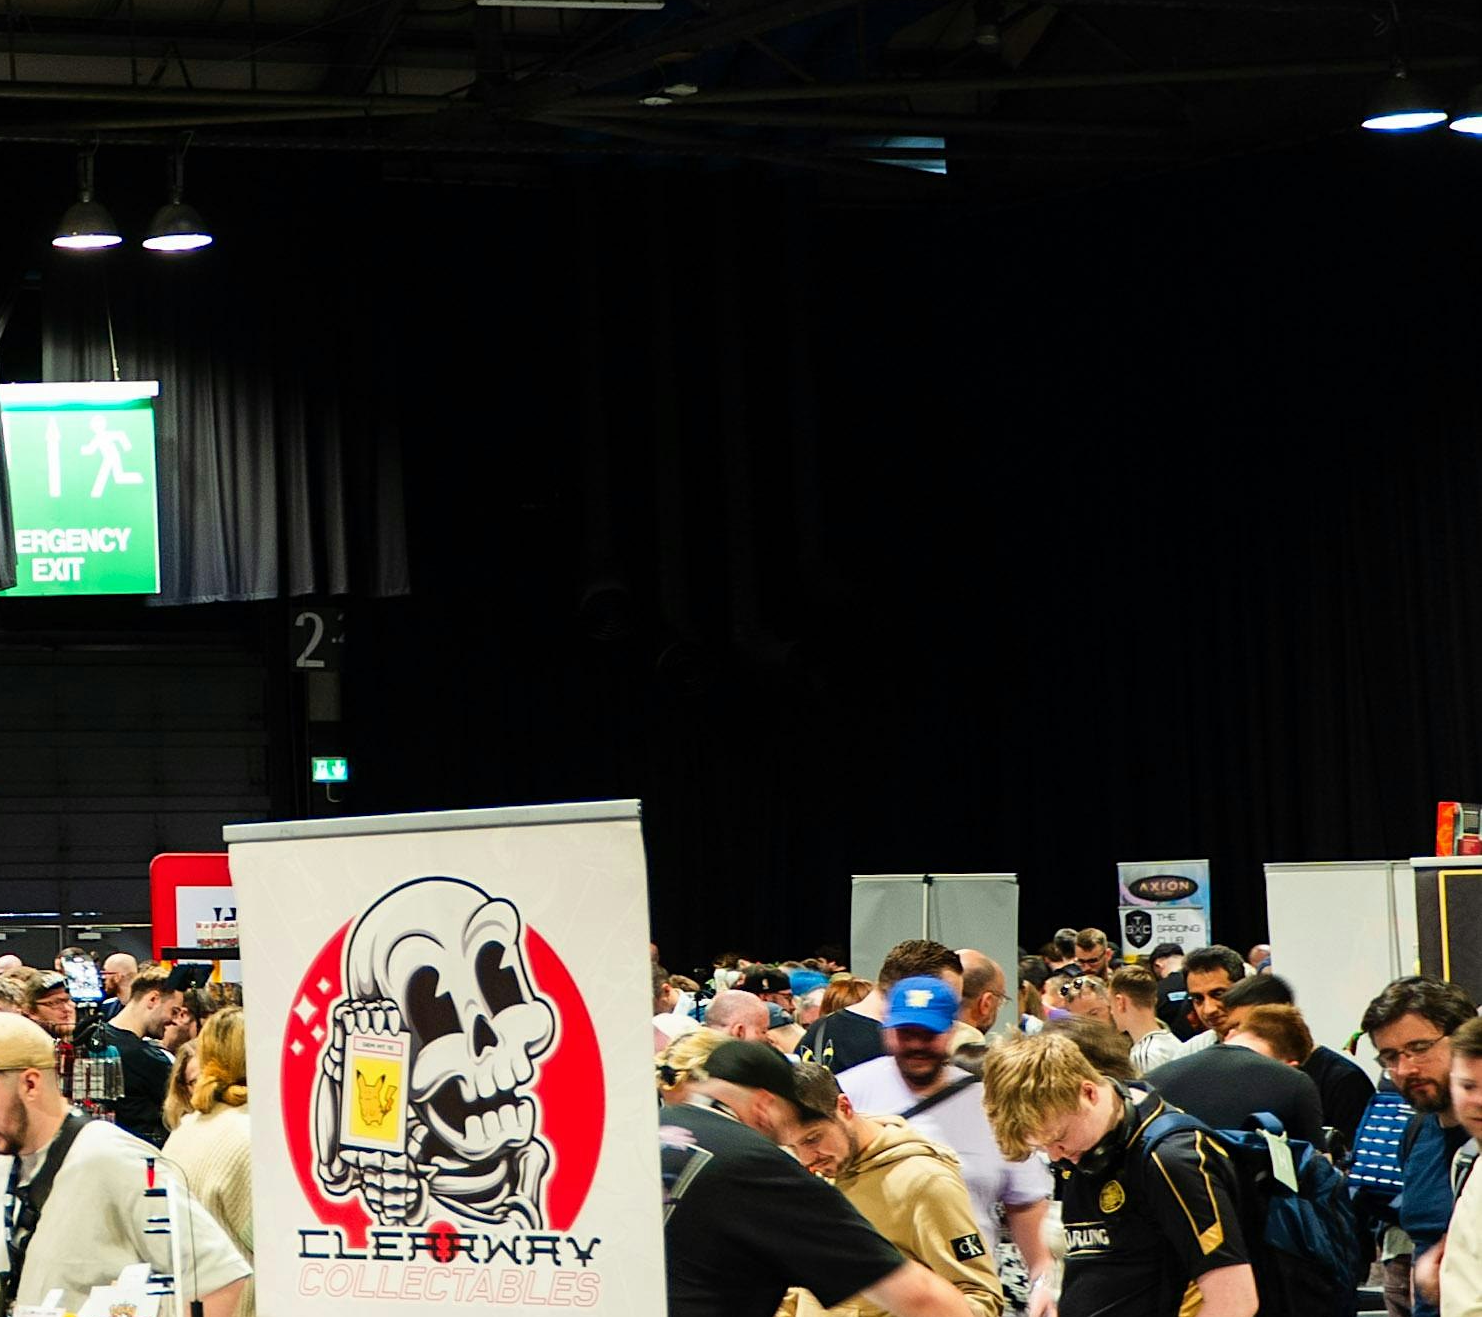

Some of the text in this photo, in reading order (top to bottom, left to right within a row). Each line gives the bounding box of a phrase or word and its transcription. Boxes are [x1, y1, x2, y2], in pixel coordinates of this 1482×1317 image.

[16, 527, 132, 554] ERGENCY
[32, 557, 86, 582] EXIT
[1139, 880, 1190, 892] AXION
[298, 1229, 602, 1268] CLEARWAY
[298, 1262, 602, 1308] COLLECTABLES
